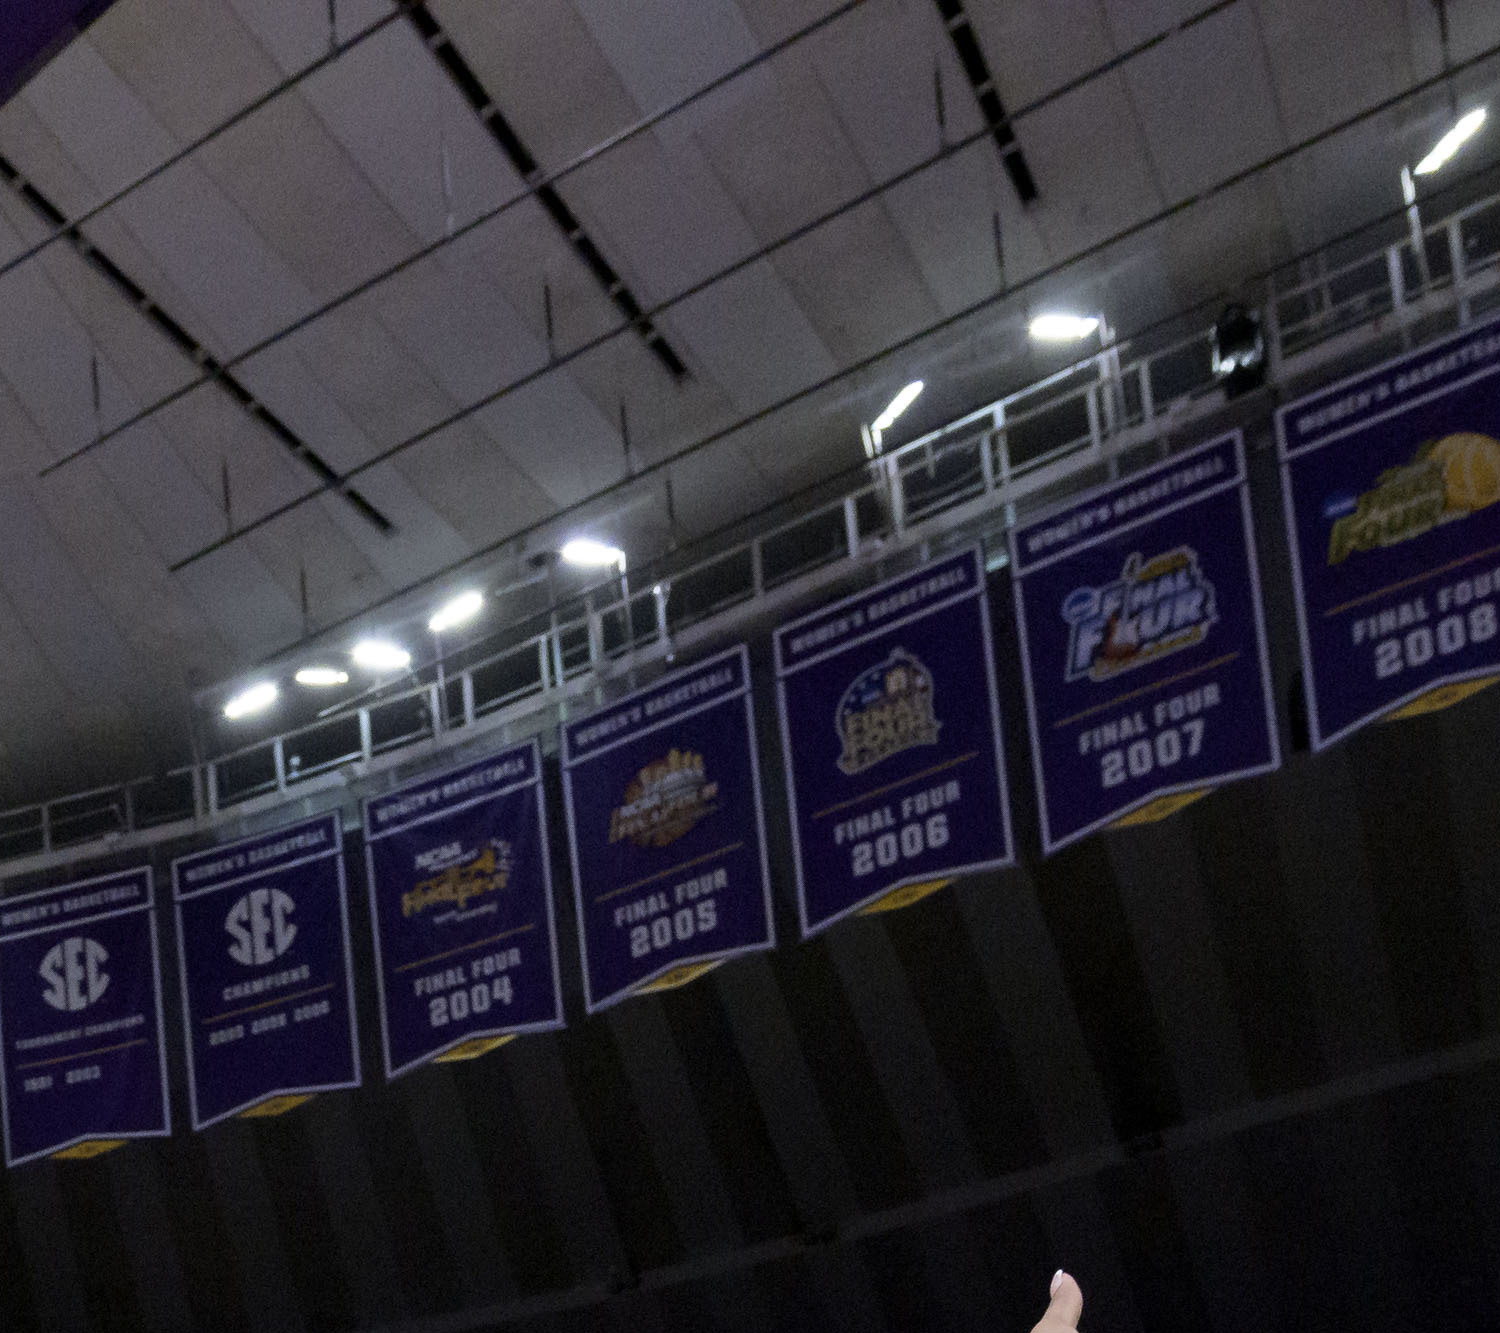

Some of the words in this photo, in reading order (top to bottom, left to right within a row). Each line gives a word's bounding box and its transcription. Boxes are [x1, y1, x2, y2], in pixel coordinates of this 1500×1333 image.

[1114, 456, 1225, 515] BASKETBALL
[867, 565, 967, 620] BASKETBALL
[1352, 597, 1429, 646] FINAL
[1374, 603, 1498, 681] 2008
[644, 667, 734, 716] BASKETBALL
[1078, 715, 1148, 756] FINAL
[1153, 682, 1221, 725] FOUR
[442, 757, 526, 798] BASKETBALL
[1101, 720, 1205, 788] 2007
[833, 806, 896, 845] FINAL
[901, 780, 961, 818] FOUR
[851, 812, 950, 878] 2006
[63, 883, 141, 913] BASKETBALL
[614, 891, 670, 927] FINAL
[675, 867, 728, 904] FOUR
[224, 888, 297, 966] SEC
[629, 898, 718, 958] 2005
[39, 936, 110, 1011] SEC
[222, 963, 311, 1001] CHAMPIONS
[413, 966, 467, 998] FINAL
[470, 947, 521, 980] FOUR
[428, 974, 513, 1028] 2004
